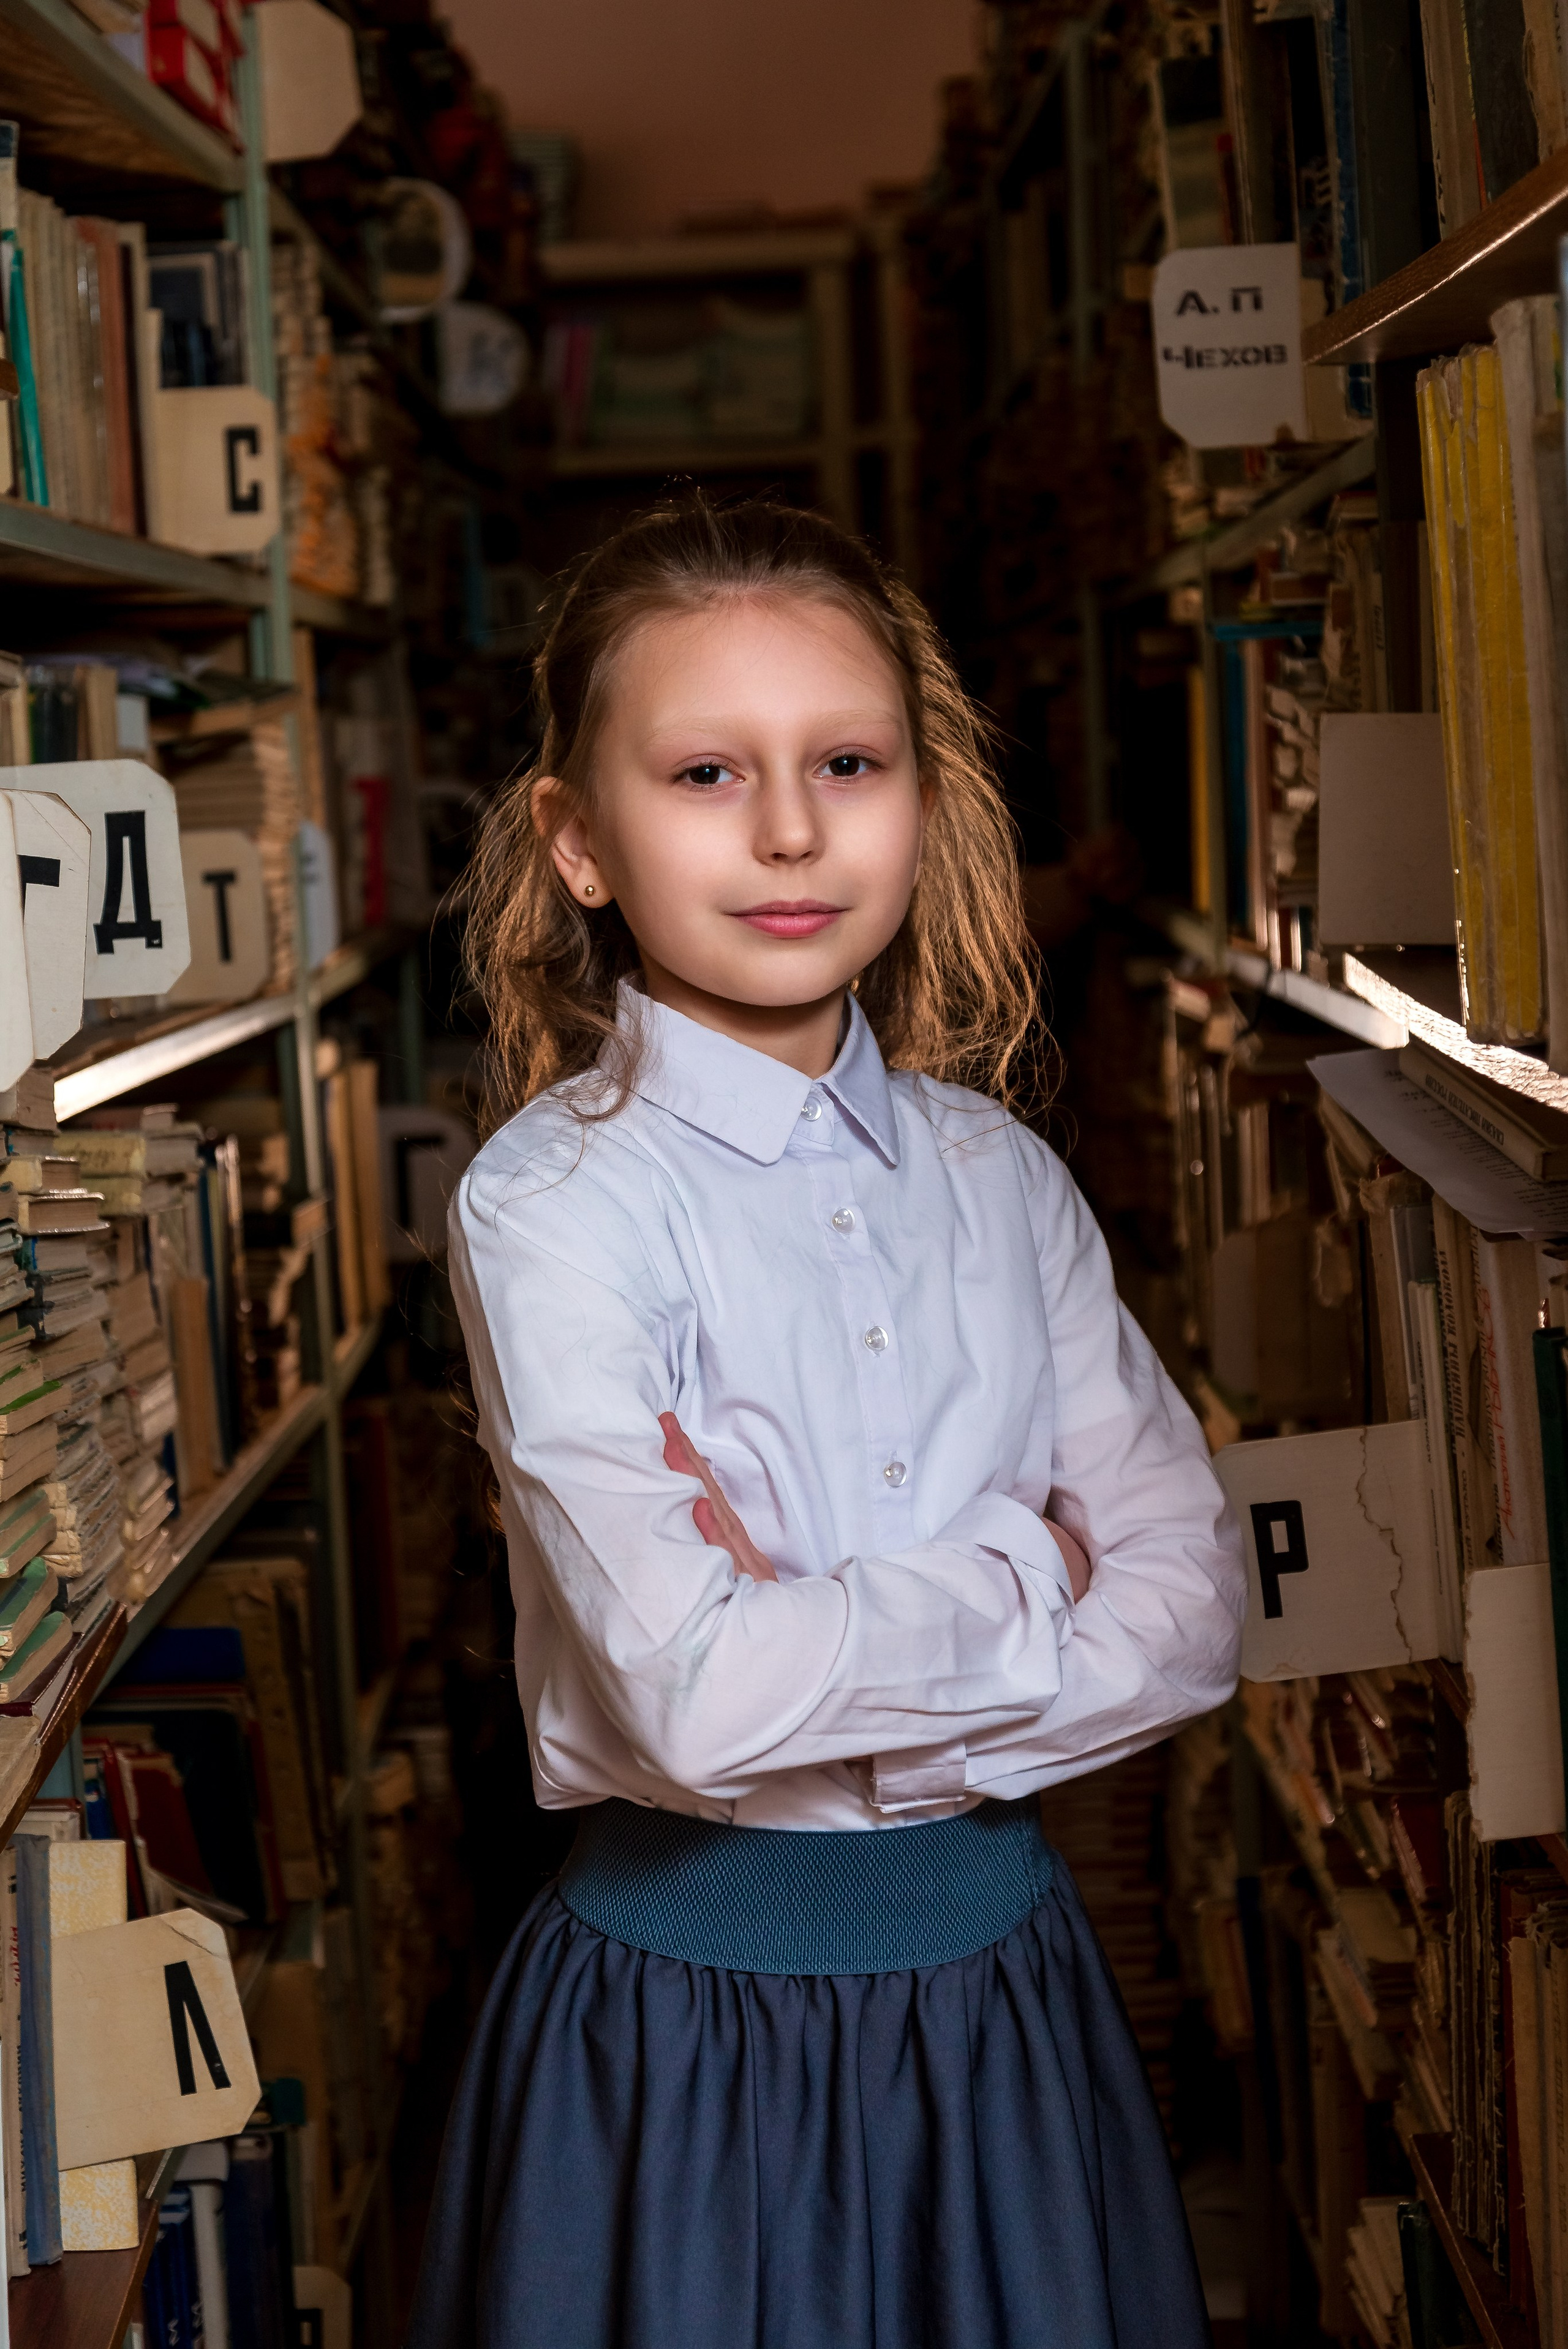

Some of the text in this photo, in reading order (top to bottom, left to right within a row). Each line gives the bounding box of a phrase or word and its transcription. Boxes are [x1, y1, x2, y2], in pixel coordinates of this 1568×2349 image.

[223, 424, 260, 514] С
[93, 810, 163, 954] Д
[202, 870, 238, 964] Т
[395, 1133, 444, 1228] Г
[1439, 1250, 1457, 1337] КОЛОКОЛА
[1250, 1499, 1310, 1620] Р
[164, 1961, 232, 2095] Л
